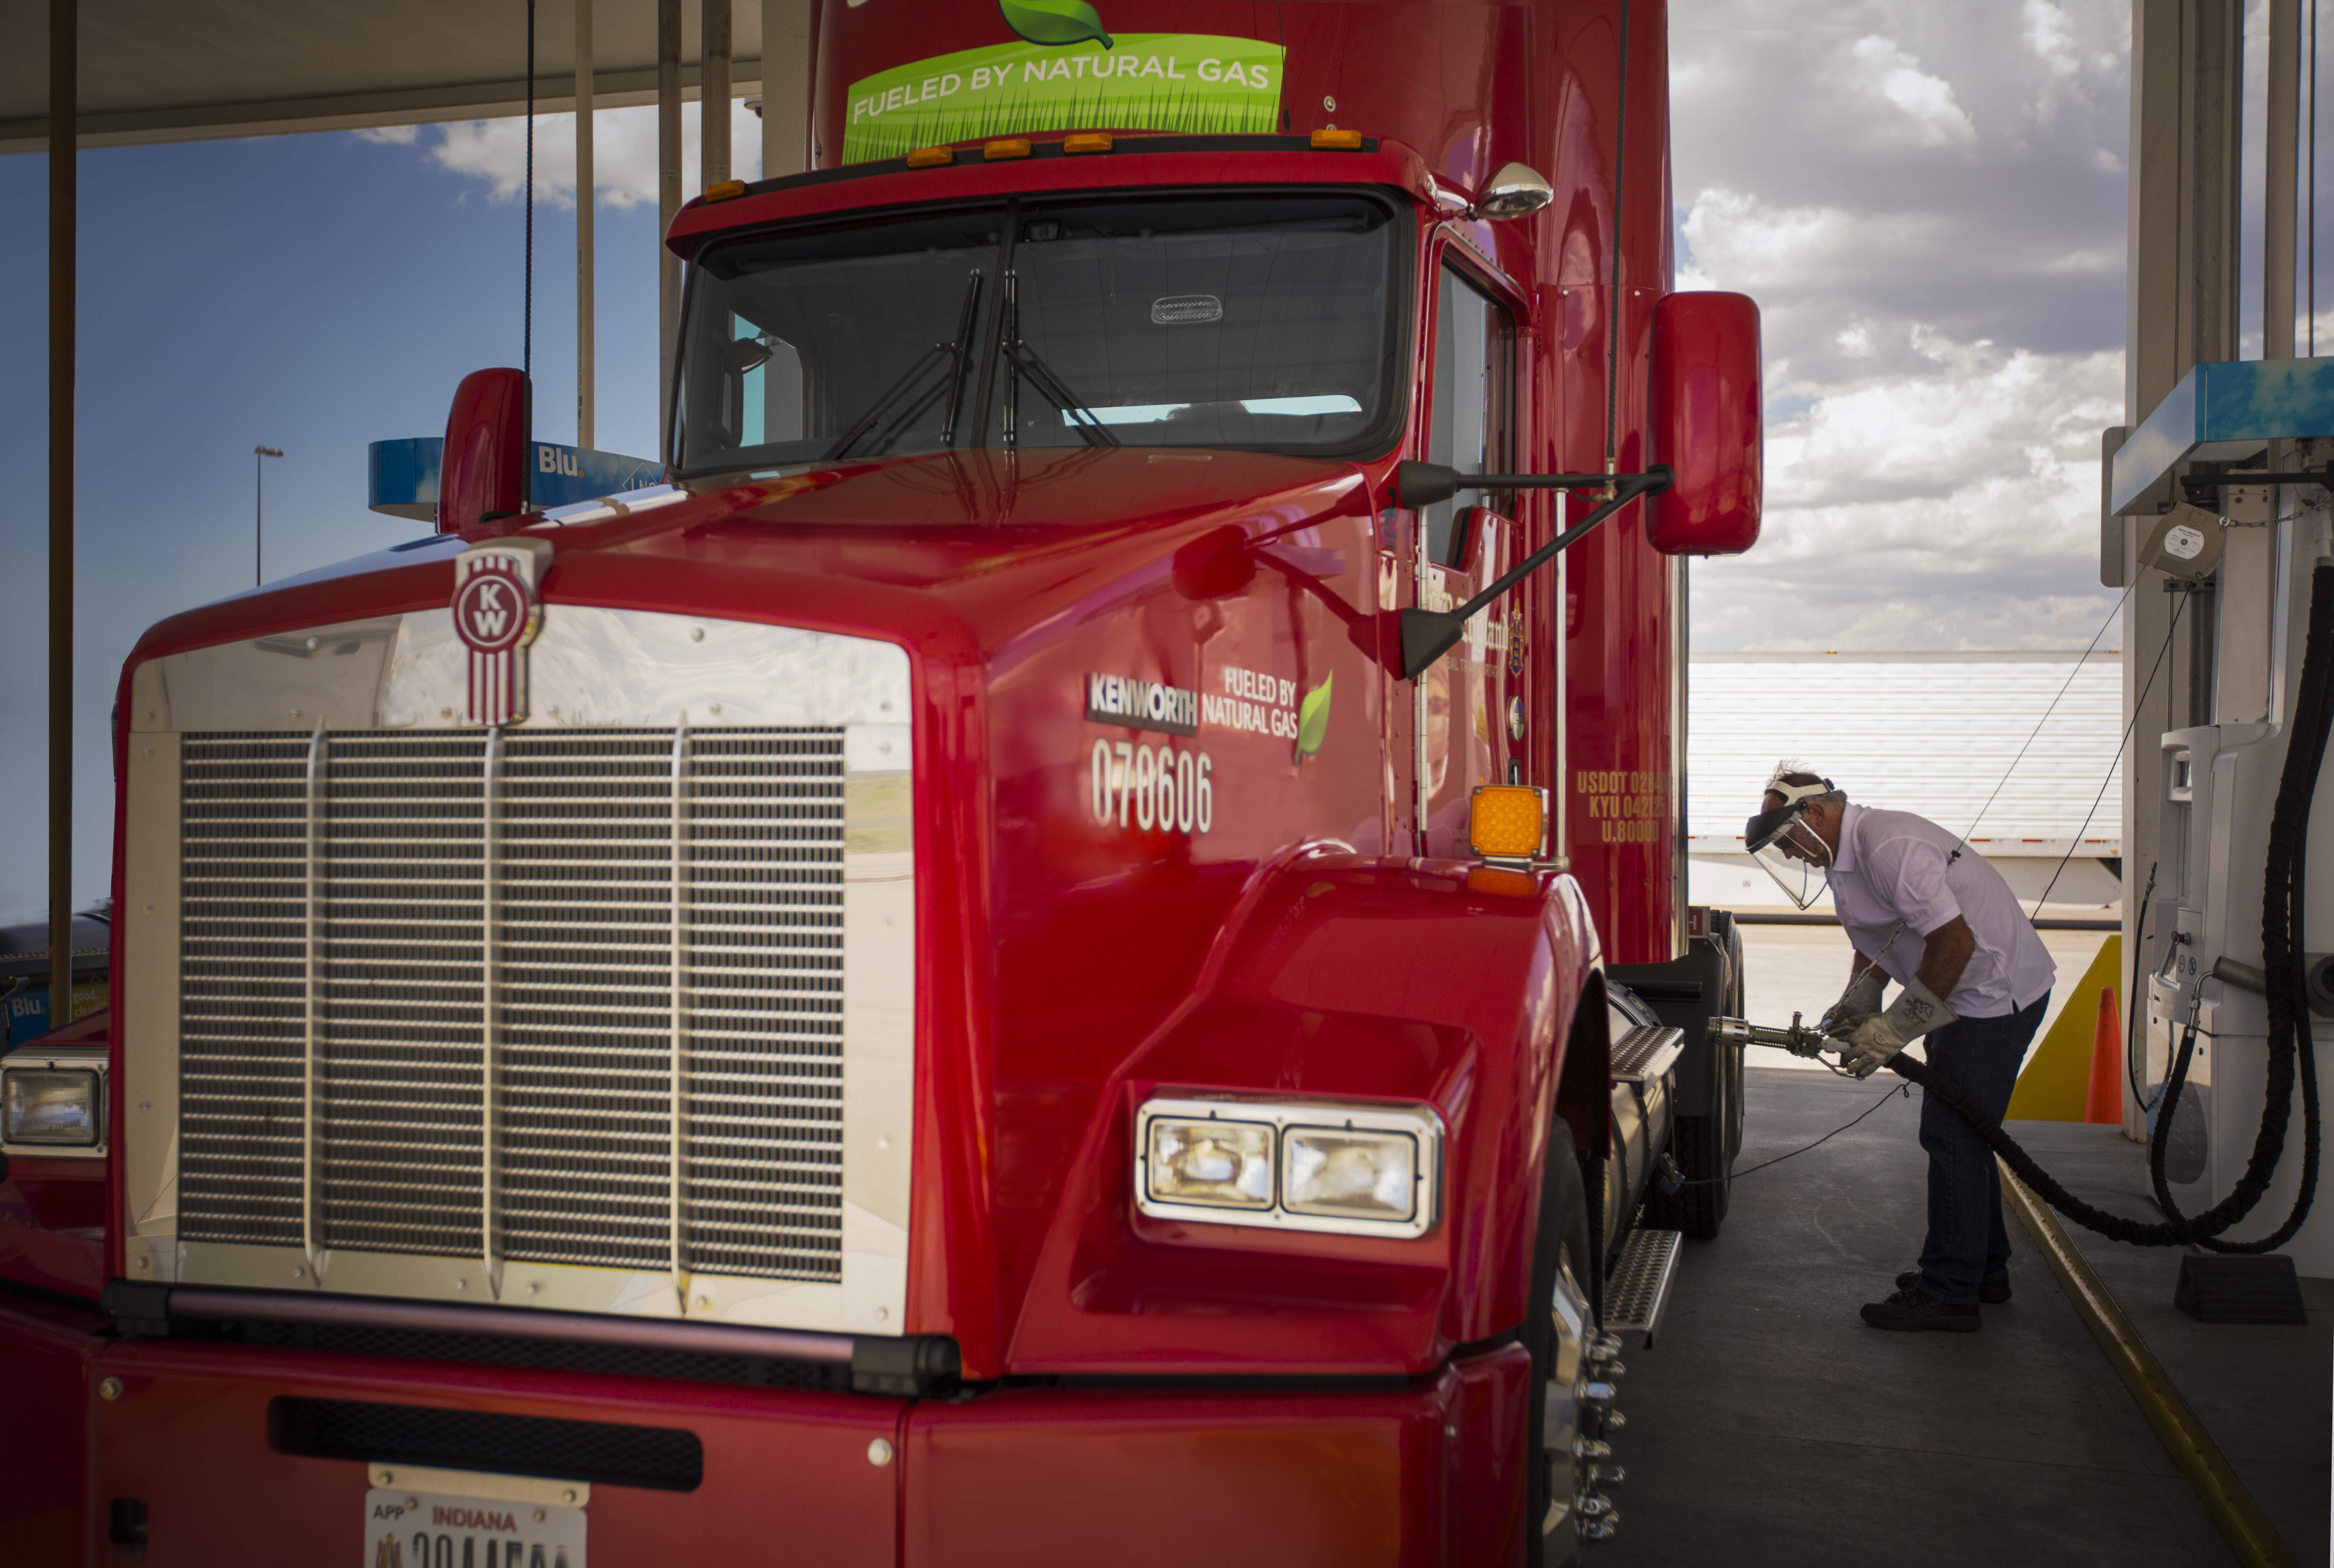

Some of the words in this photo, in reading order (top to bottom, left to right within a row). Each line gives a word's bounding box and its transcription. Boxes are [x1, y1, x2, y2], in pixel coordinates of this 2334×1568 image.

[853, 74, 961, 124] FUELED
[971, 63, 1015, 91] BY
[1024, 55, 1186, 83] NATURAL
[1197, 58, 1269, 89] GAS
[1090, 672, 1197, 726] KENWORTH
[1225, 667, 1276, 703] FUELED
[1279, 679, 1296, 707] BY
[1202, 693, 1269, 734] NATURAL
[1271, 708, 1298, 739] GAS
[1091, 738, 1213, 835] 070606
[1577, 771, 1628, 793] USDOT
[1590, 796, 1619, 818] KYU
[372, 1504, 405, 1520] APP
[432, 1505, 518, 1532] INDIANA
